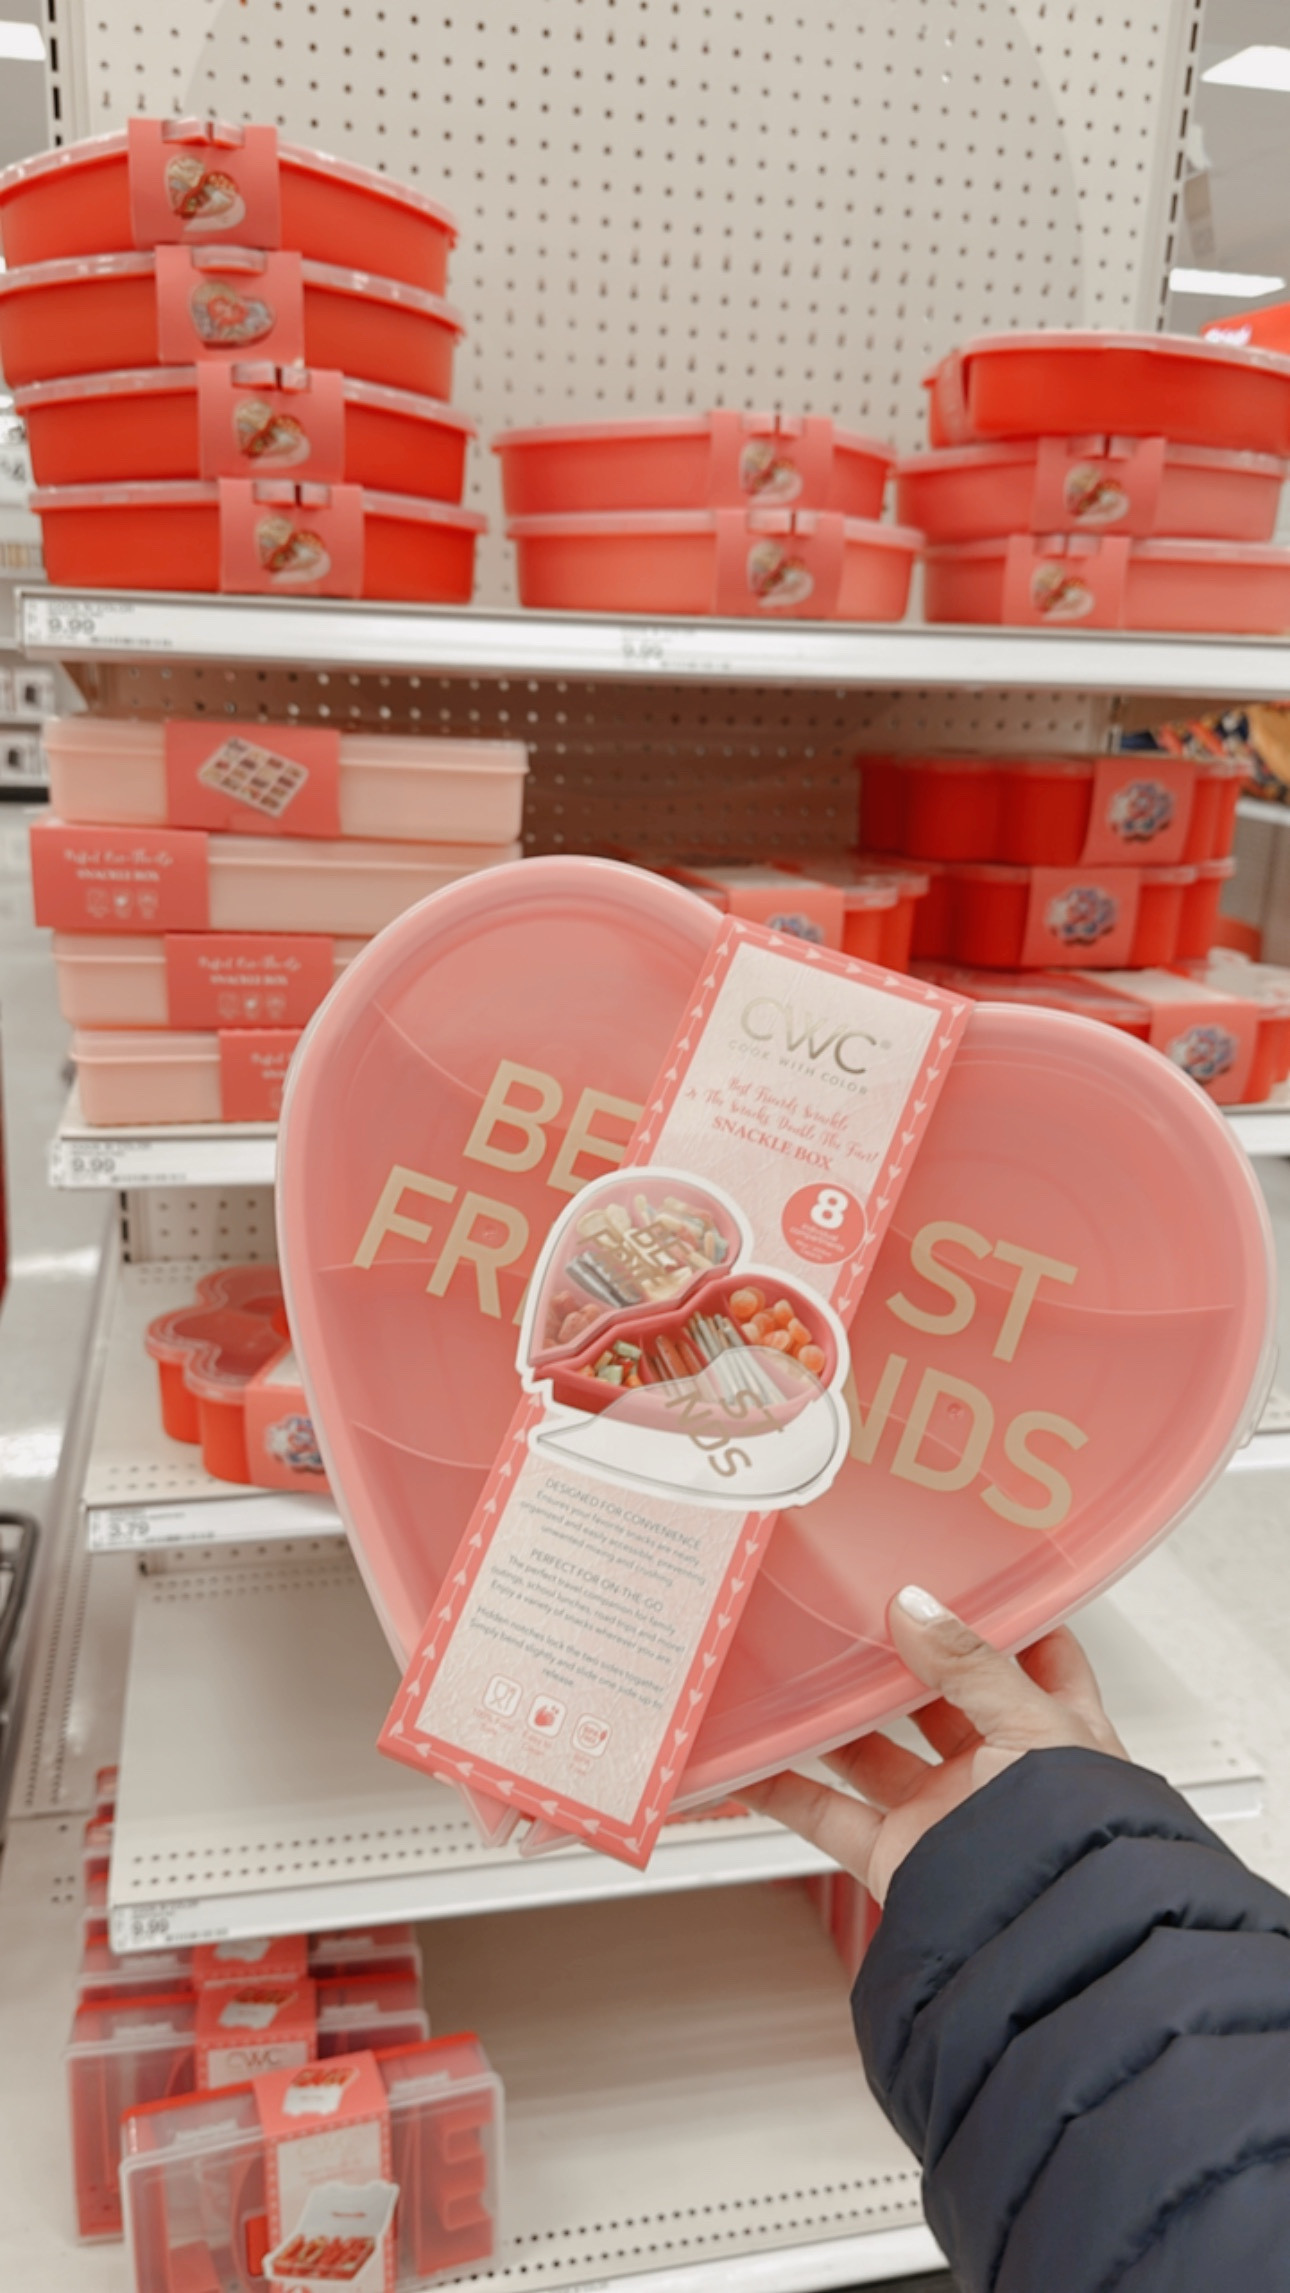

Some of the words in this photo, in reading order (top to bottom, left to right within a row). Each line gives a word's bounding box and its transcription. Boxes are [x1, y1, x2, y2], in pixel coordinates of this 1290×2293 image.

[49, 618, 96, 636] 9.99
[740, 995, 878, 1075] CWC
[727, 1039, 769, 1062] COOK
[777, 1056, 816, 1078] WITH
[818, 1071, 868, 1097] COLOR
[72, 1157, 116, 1173] 9.99
[711, 1115, 794, 1155] SNACKLE
[793, 1145, 834, 1170] BOX
[811, 1189, 848, 1229] 8
[536, 1489, 571, 1510] Ensures
[569, 1506, 590, 1521] your
[625, 1528, 656, 1547] snacks
[656, 1543, 672, 1554] are
[544, 1477, 599, 1507] DESIGNED
[599, 1500, 623, 1518] FOR
[621, 1509, 701, 1551] CONVENIENCE
[529, 1547, 576, 1574] PERFECT
[575, 1567, 600, 1585] FOR
[539, 1524, 584, 1547] unwanted
[614, 1554, 634, 1568] and
[564, 1518, 582, 1530] and
[654, 1558, 706, 1586] preventing
[508, 1554, 525, 1568] The
[523, 1563, 557, 1583] perfect
[556, 1576, 583, 1593] travel
[581, 1588, 634, 1617] companion
[633, 1607, 648, 1620] for
[526, 1578, 557, 1597] school
[593, 1608, 617, 1624] road
[637, 1626, 657, 1641] and
[475, 1604, 511, 1625] Hidden
[509, 1620, 546, 1641] notches
[545, 1634, 566, 1650] lock
[488, 1579, 516, 1599] Enjoy
[521, 1594, 553, 1615] variety
[563, 1611, 595, 1631] snacks
[635, 1645, 655, 1659] you
[467, 1616, 501, 1640] Simply
[499, 1630, 525, 1648] bend
[556, 1657, 576, 1671] and
[596, 1676, 616, 1689] one
